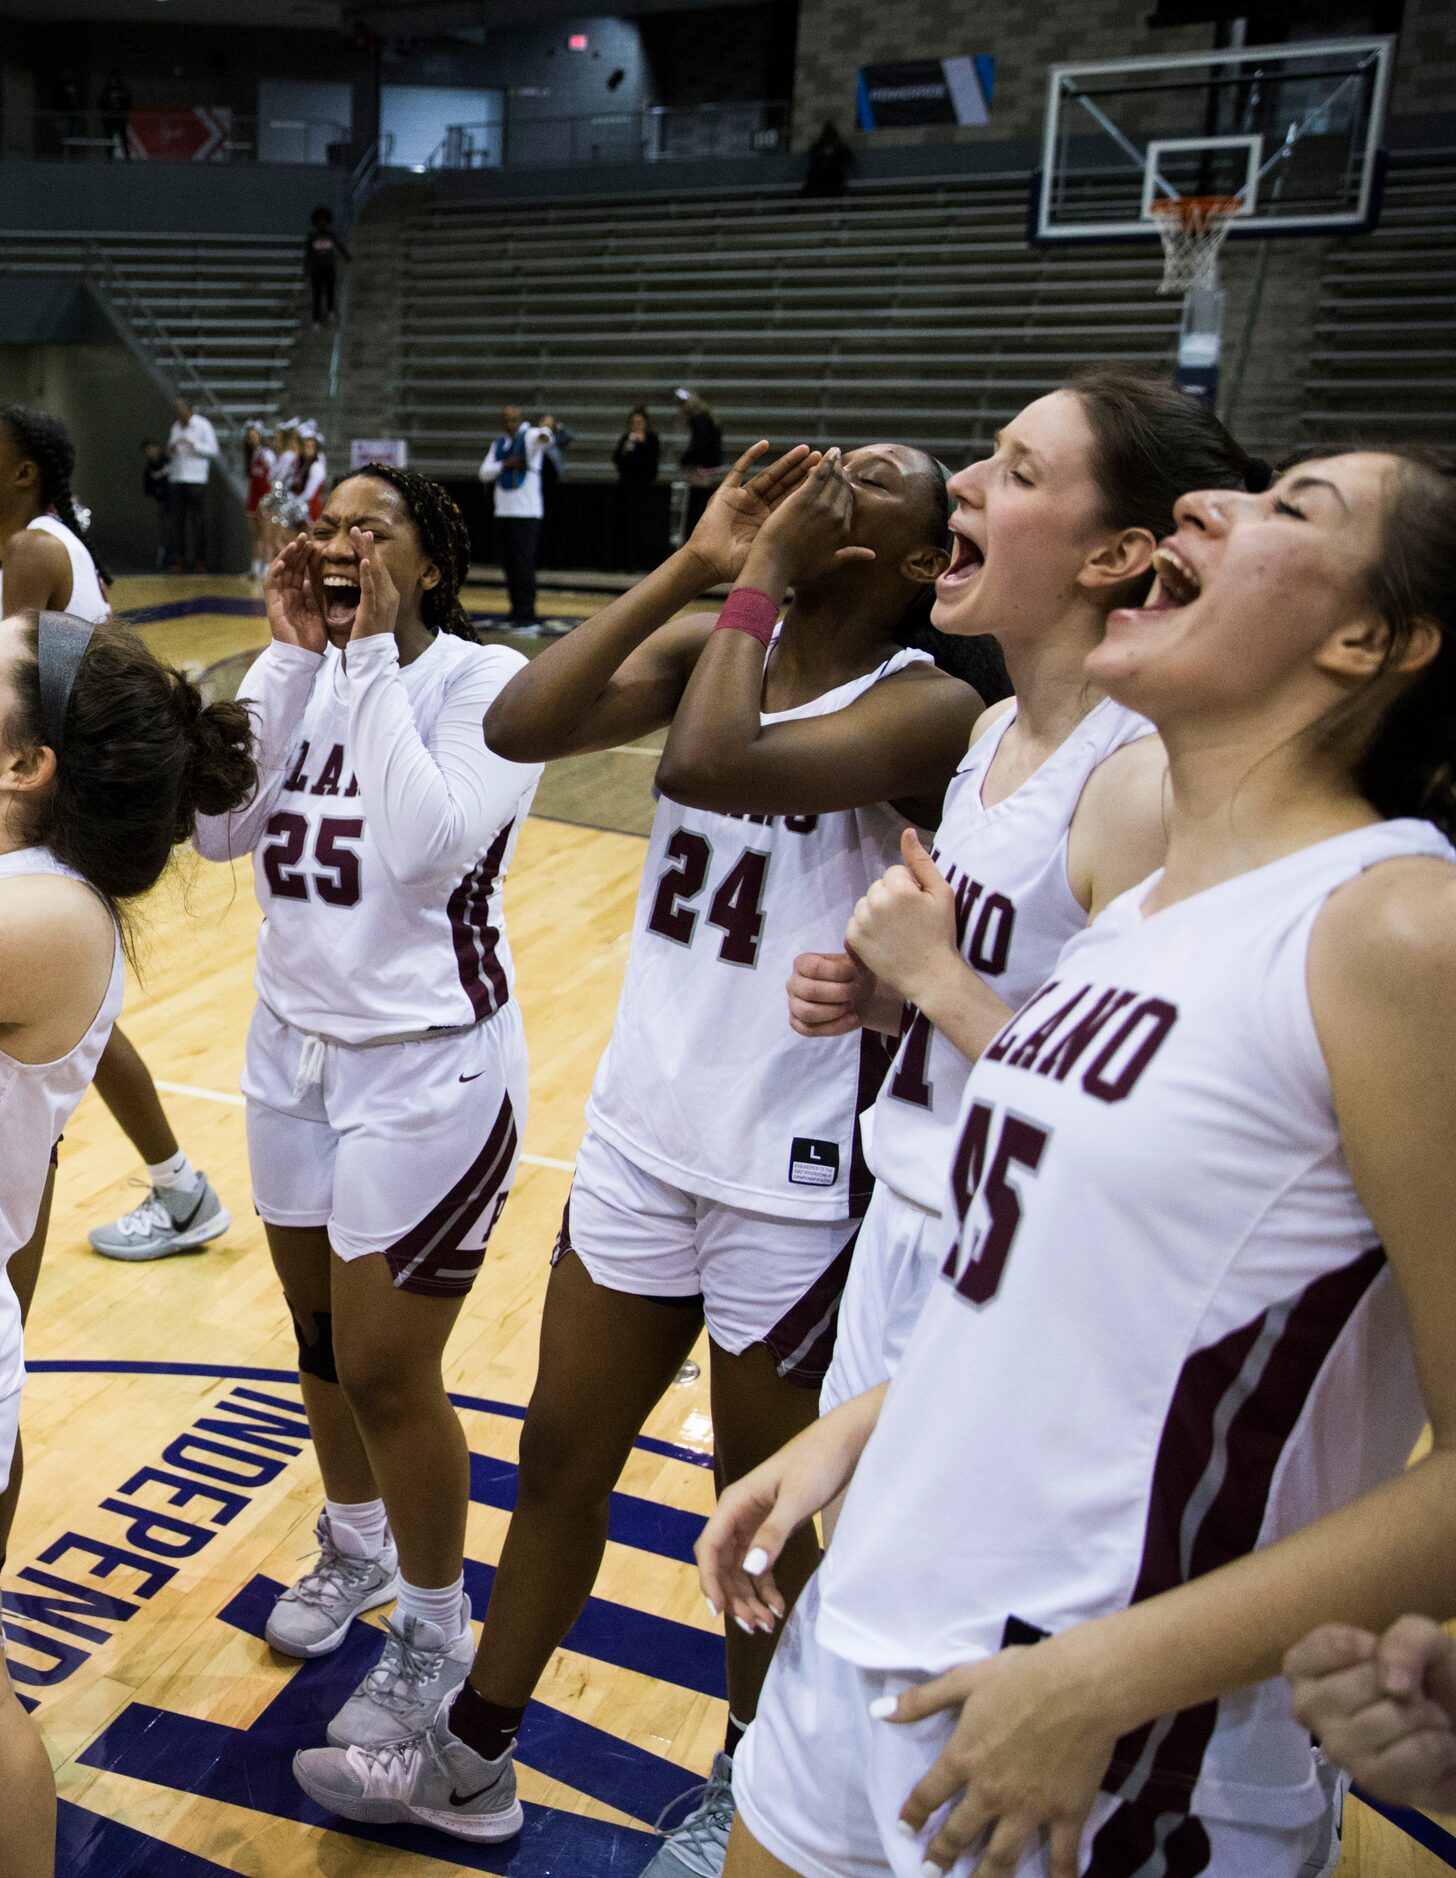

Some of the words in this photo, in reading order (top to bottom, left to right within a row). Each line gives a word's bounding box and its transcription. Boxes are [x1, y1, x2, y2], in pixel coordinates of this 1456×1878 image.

[263, 809, 366, 911] 25
[645, 825, 772, 970] 24
[810, 1145, 822, 1160] L
